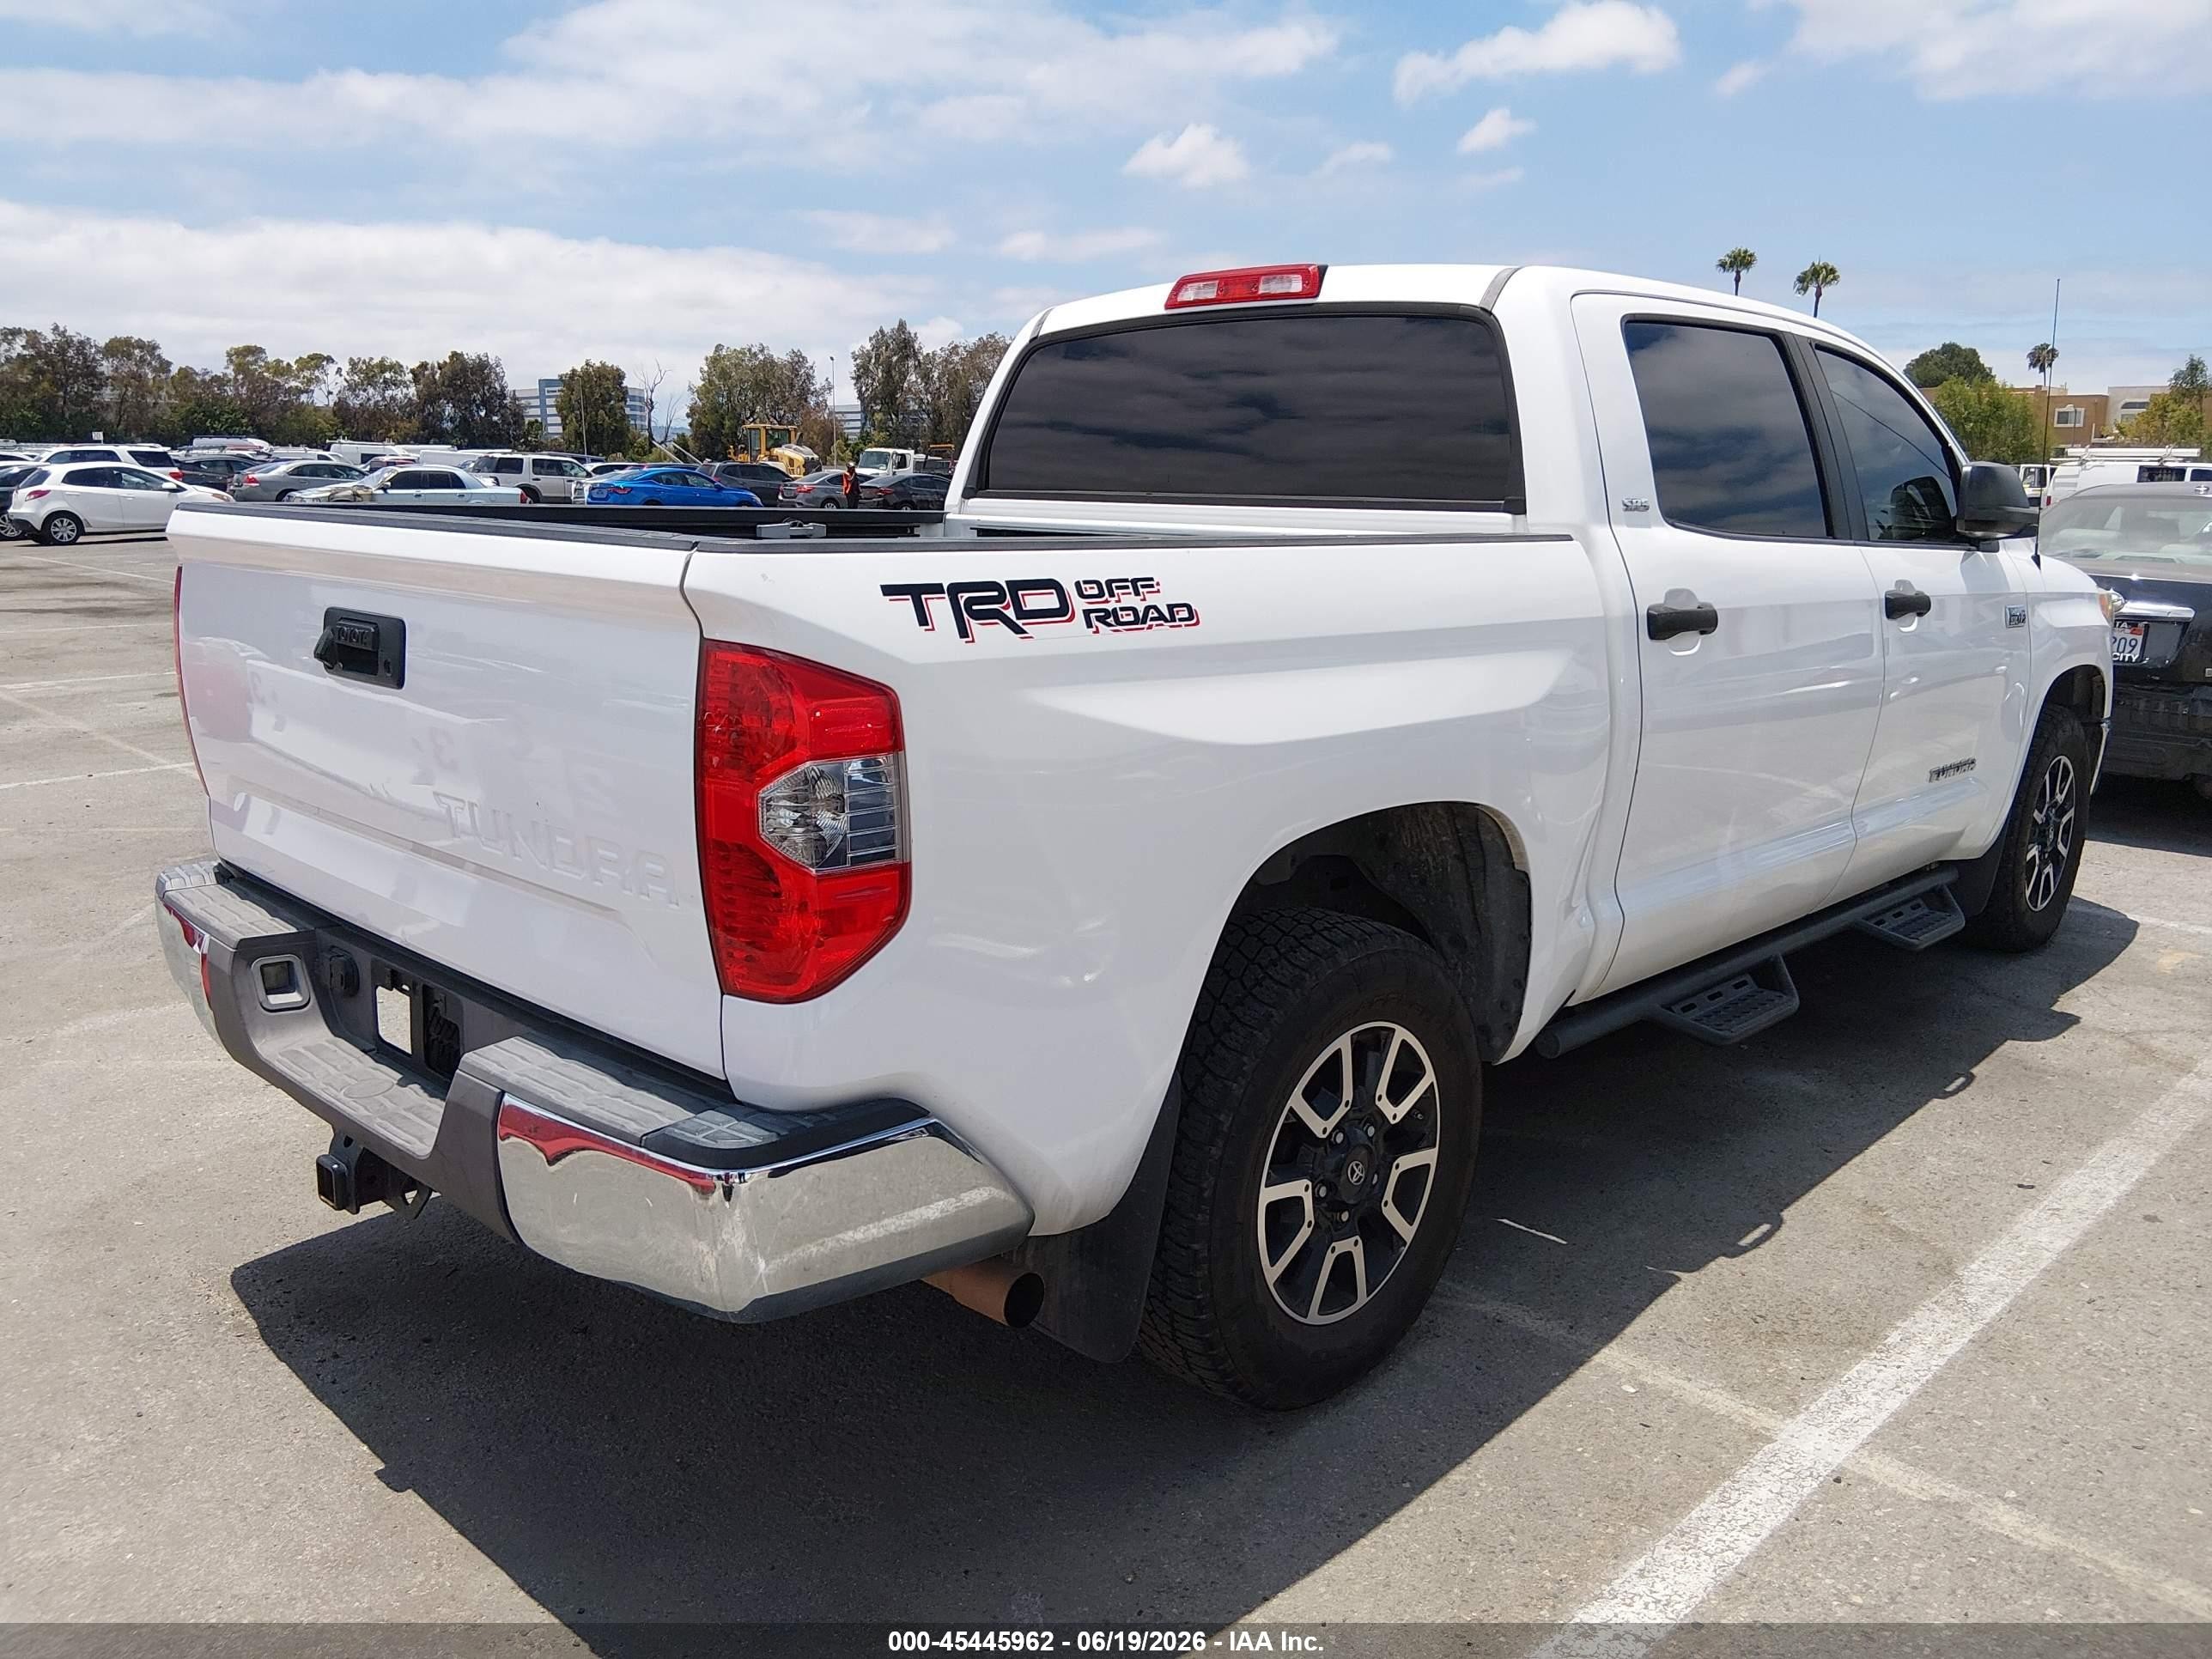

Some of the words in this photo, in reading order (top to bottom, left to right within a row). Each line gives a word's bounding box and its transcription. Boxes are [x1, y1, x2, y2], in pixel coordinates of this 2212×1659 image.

[1073, 576, 1160, 604] OFF
[879, 578, 1076, 643] TRD
[1082, 602, 1200, 634] ROAD
[2112, 652, 2140, 663] CITY
[433, 791, 679, 908] TUNDRA
